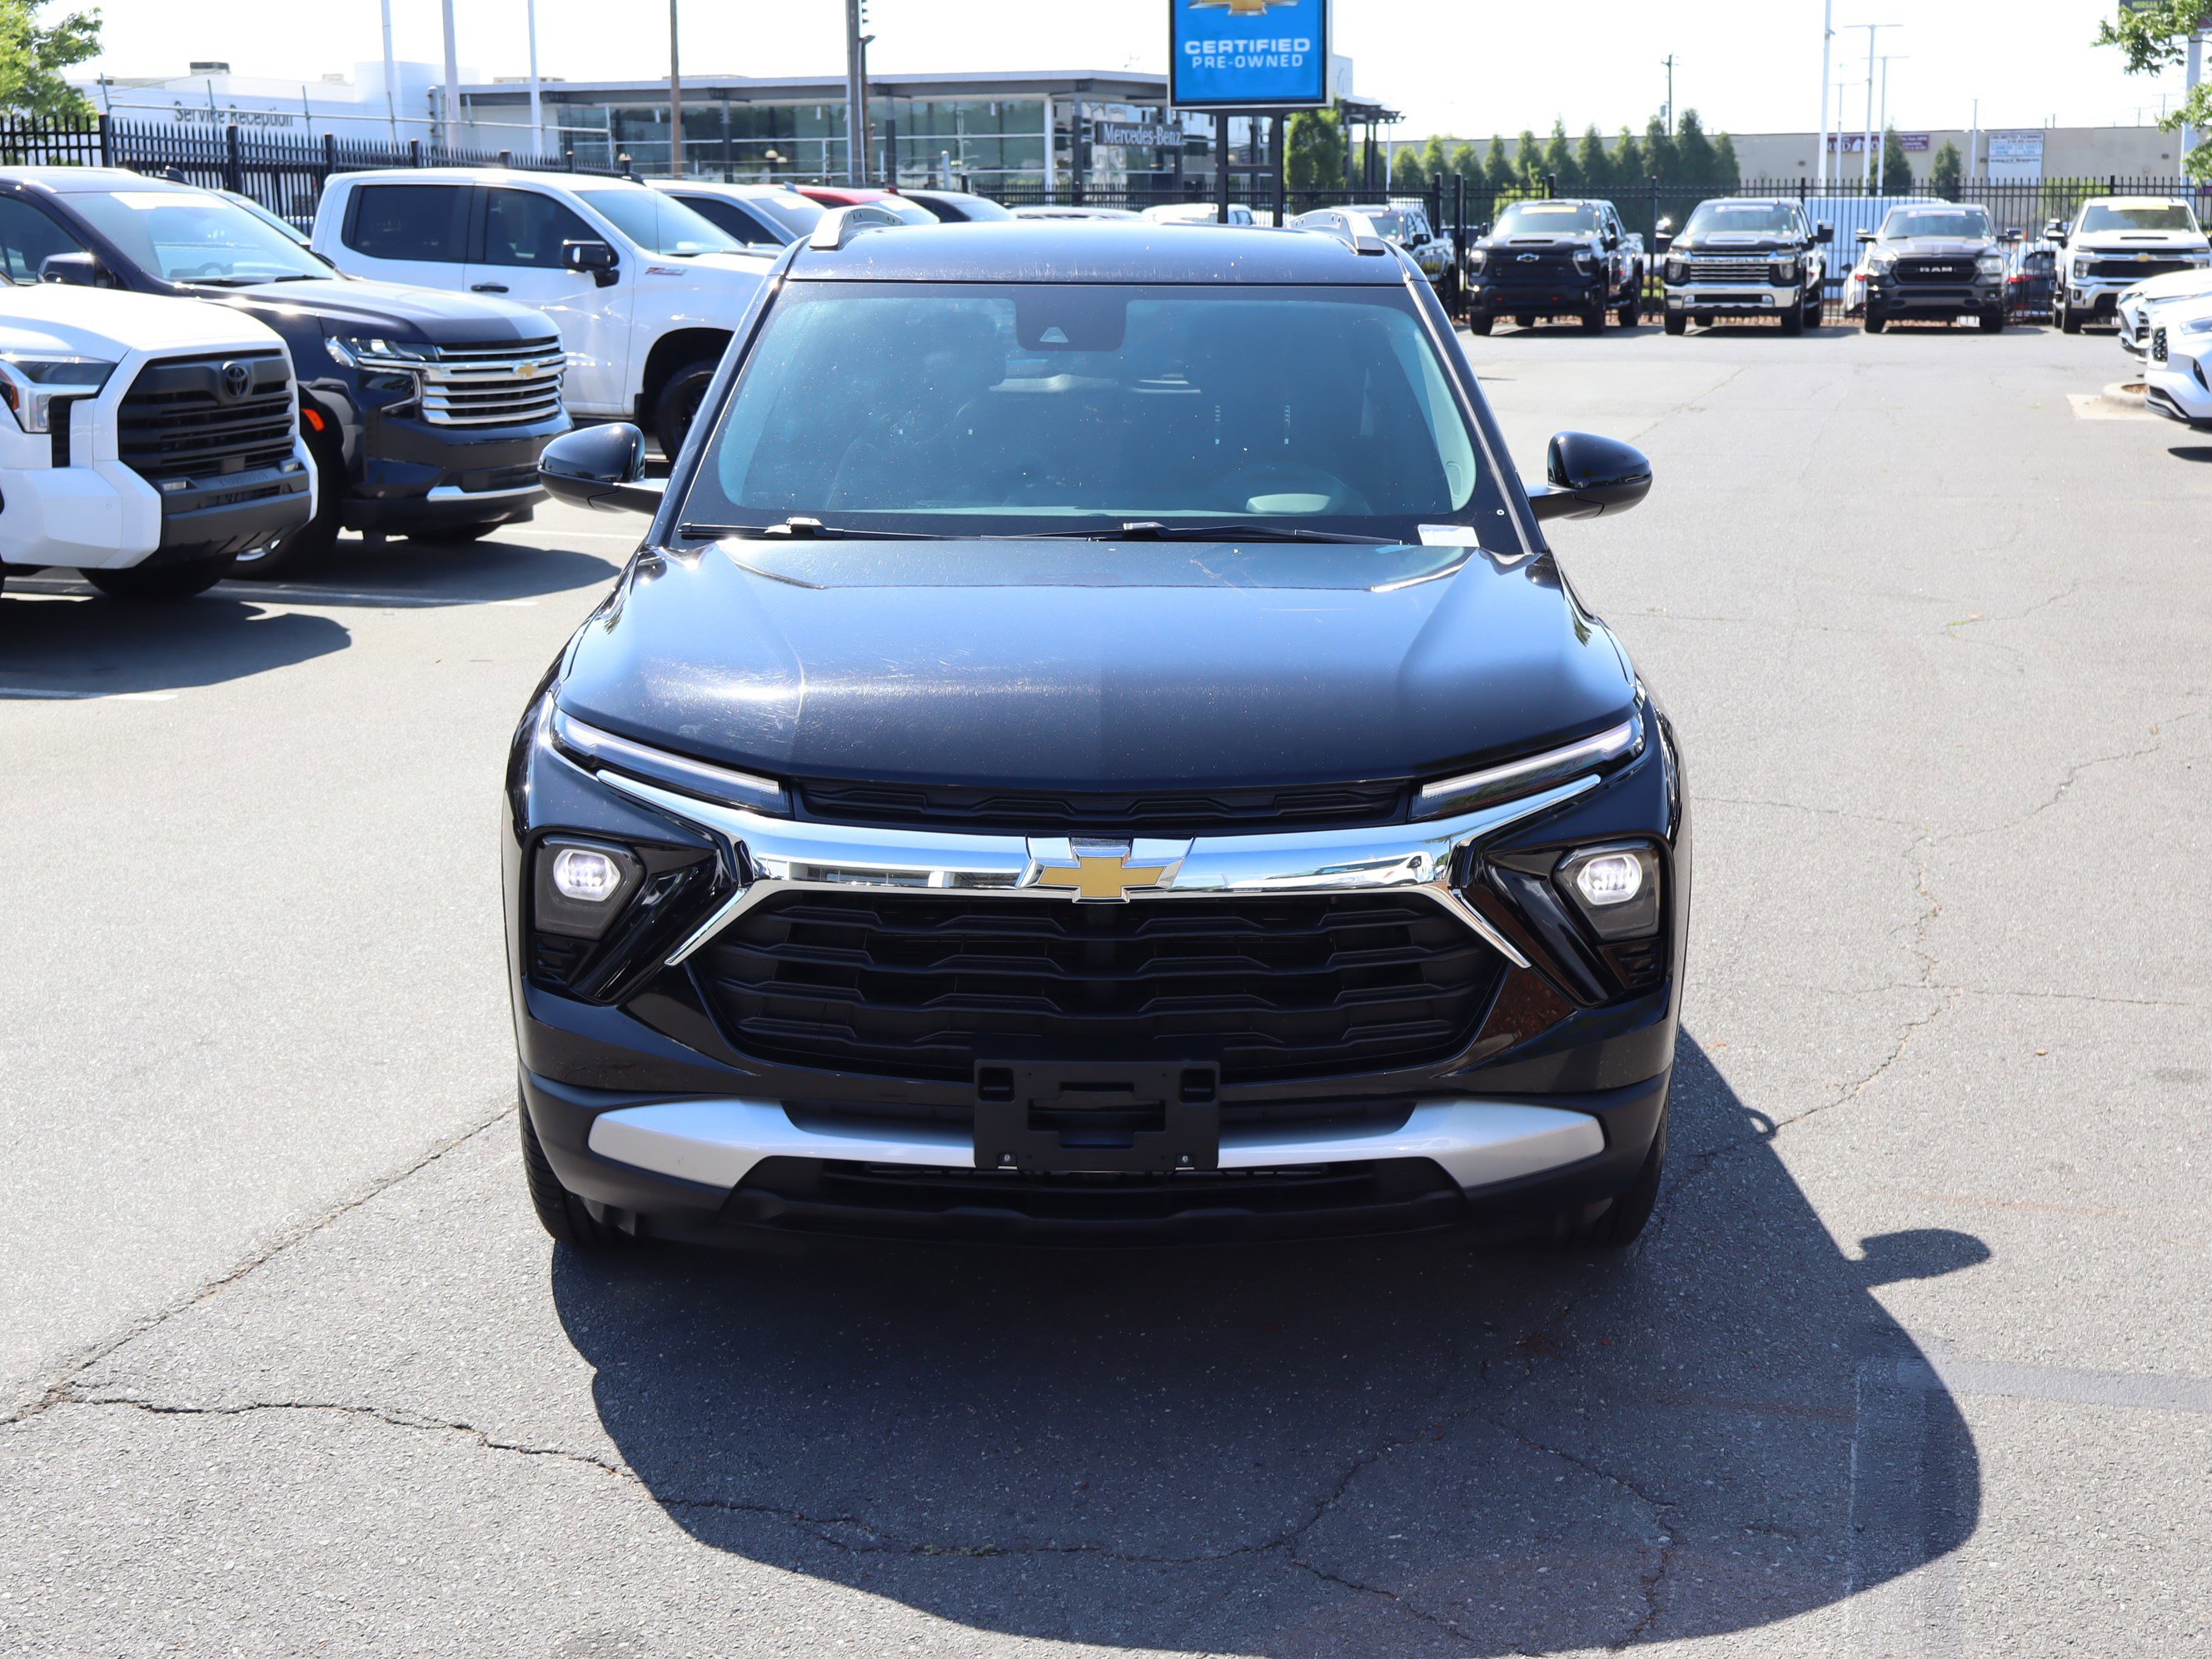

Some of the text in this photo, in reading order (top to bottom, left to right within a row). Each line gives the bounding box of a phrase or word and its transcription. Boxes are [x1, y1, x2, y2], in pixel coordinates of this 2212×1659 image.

[1184, 37, 1311, 55] CERTIFIED
[1192, 54, 1303, 68] PRE-OWNED
[173, 100, 294, 128] Service Reception
[1103, 122, 1182, 146] Mercedes-Benz
